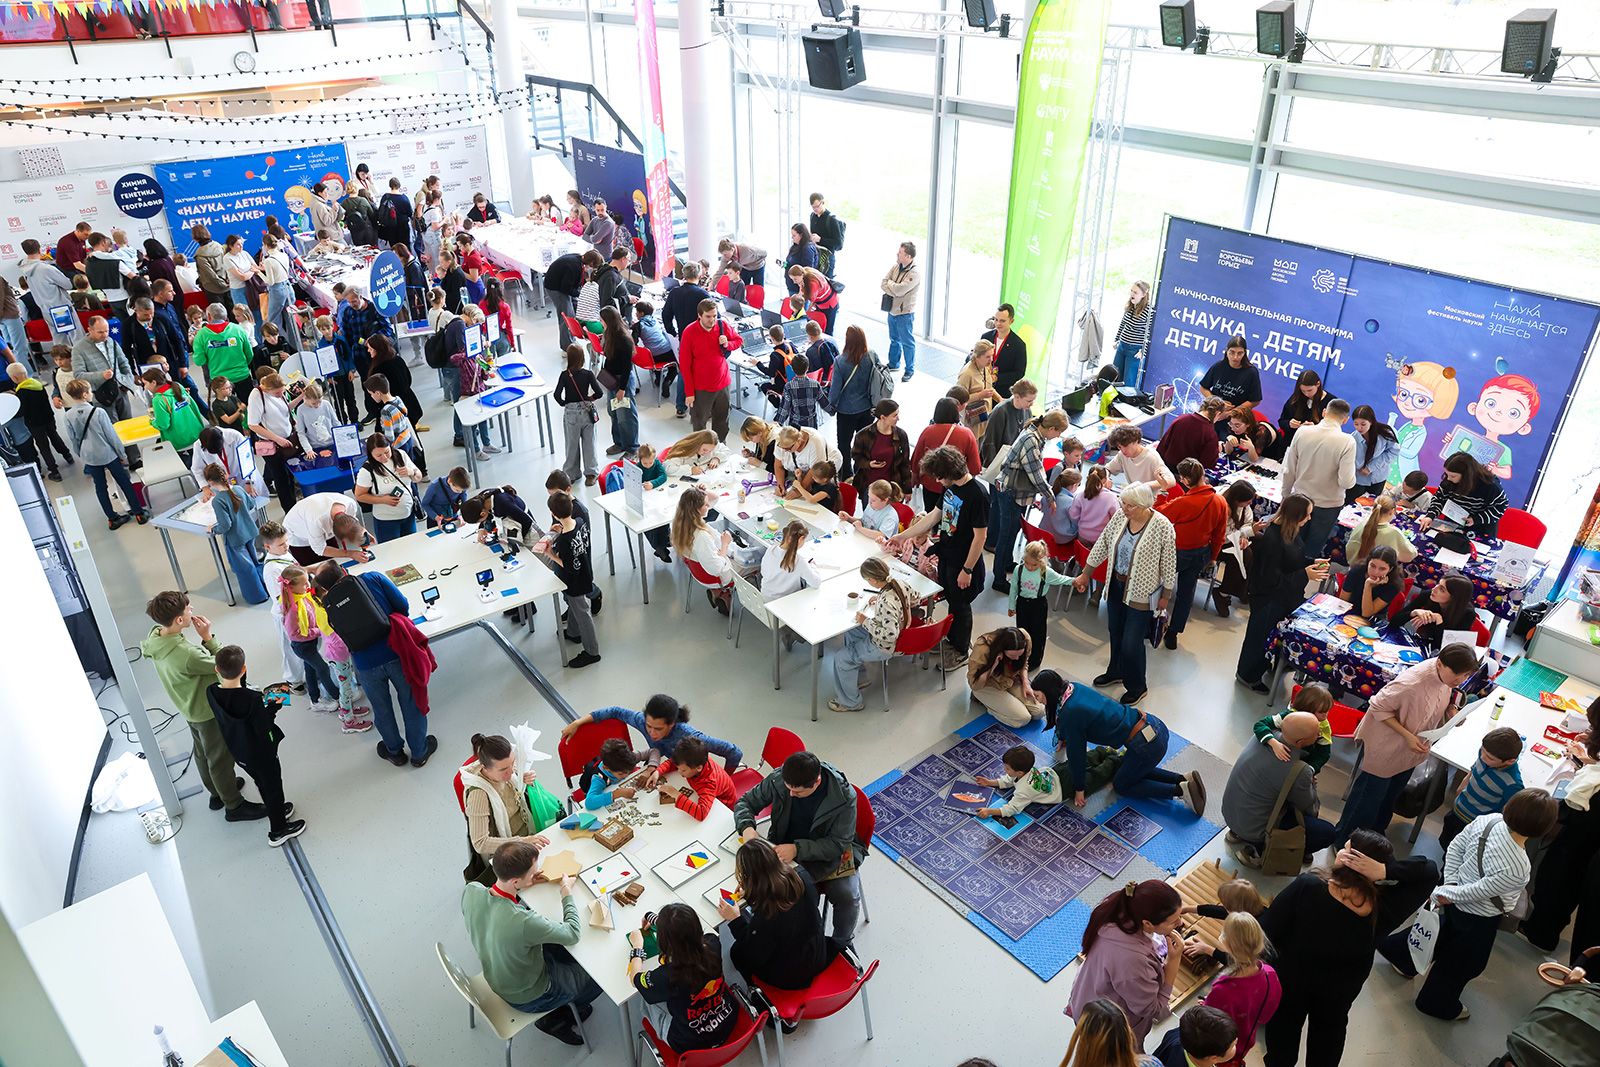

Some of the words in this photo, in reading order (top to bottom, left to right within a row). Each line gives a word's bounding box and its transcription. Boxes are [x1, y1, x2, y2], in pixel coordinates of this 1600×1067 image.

[121, 179, 147, 188] ХИМИЯ
[244, 187, 275, 196] ПРОГРАММА
[120, 189, 156, 199] ГЕНЕТИКА
[121, 199, 163, 211] ГЕОГРАФИЯ
[177, 203, 224, 217] «НАУКА
[235, 195, 276, 209] ДЕТЯМ,
[181, 219, 212, 230] ДЕТИ
[221, 209, 266, 224] НАУКЕ»
[1174, 286, 1292, 325] НАУЧНО-ПОЗНАВАТЕЛЬНАЯ
[1294, 317, 1354, 341] ПРОГРАММА
[1444, 305, 1486, 320] Московский
[1164, 327, 1218, 356] ДЕТИ
[1170, 307, 1247, 340] «НАУКА
[1263, 330, 1346, 371] ДЕТЯМ,
